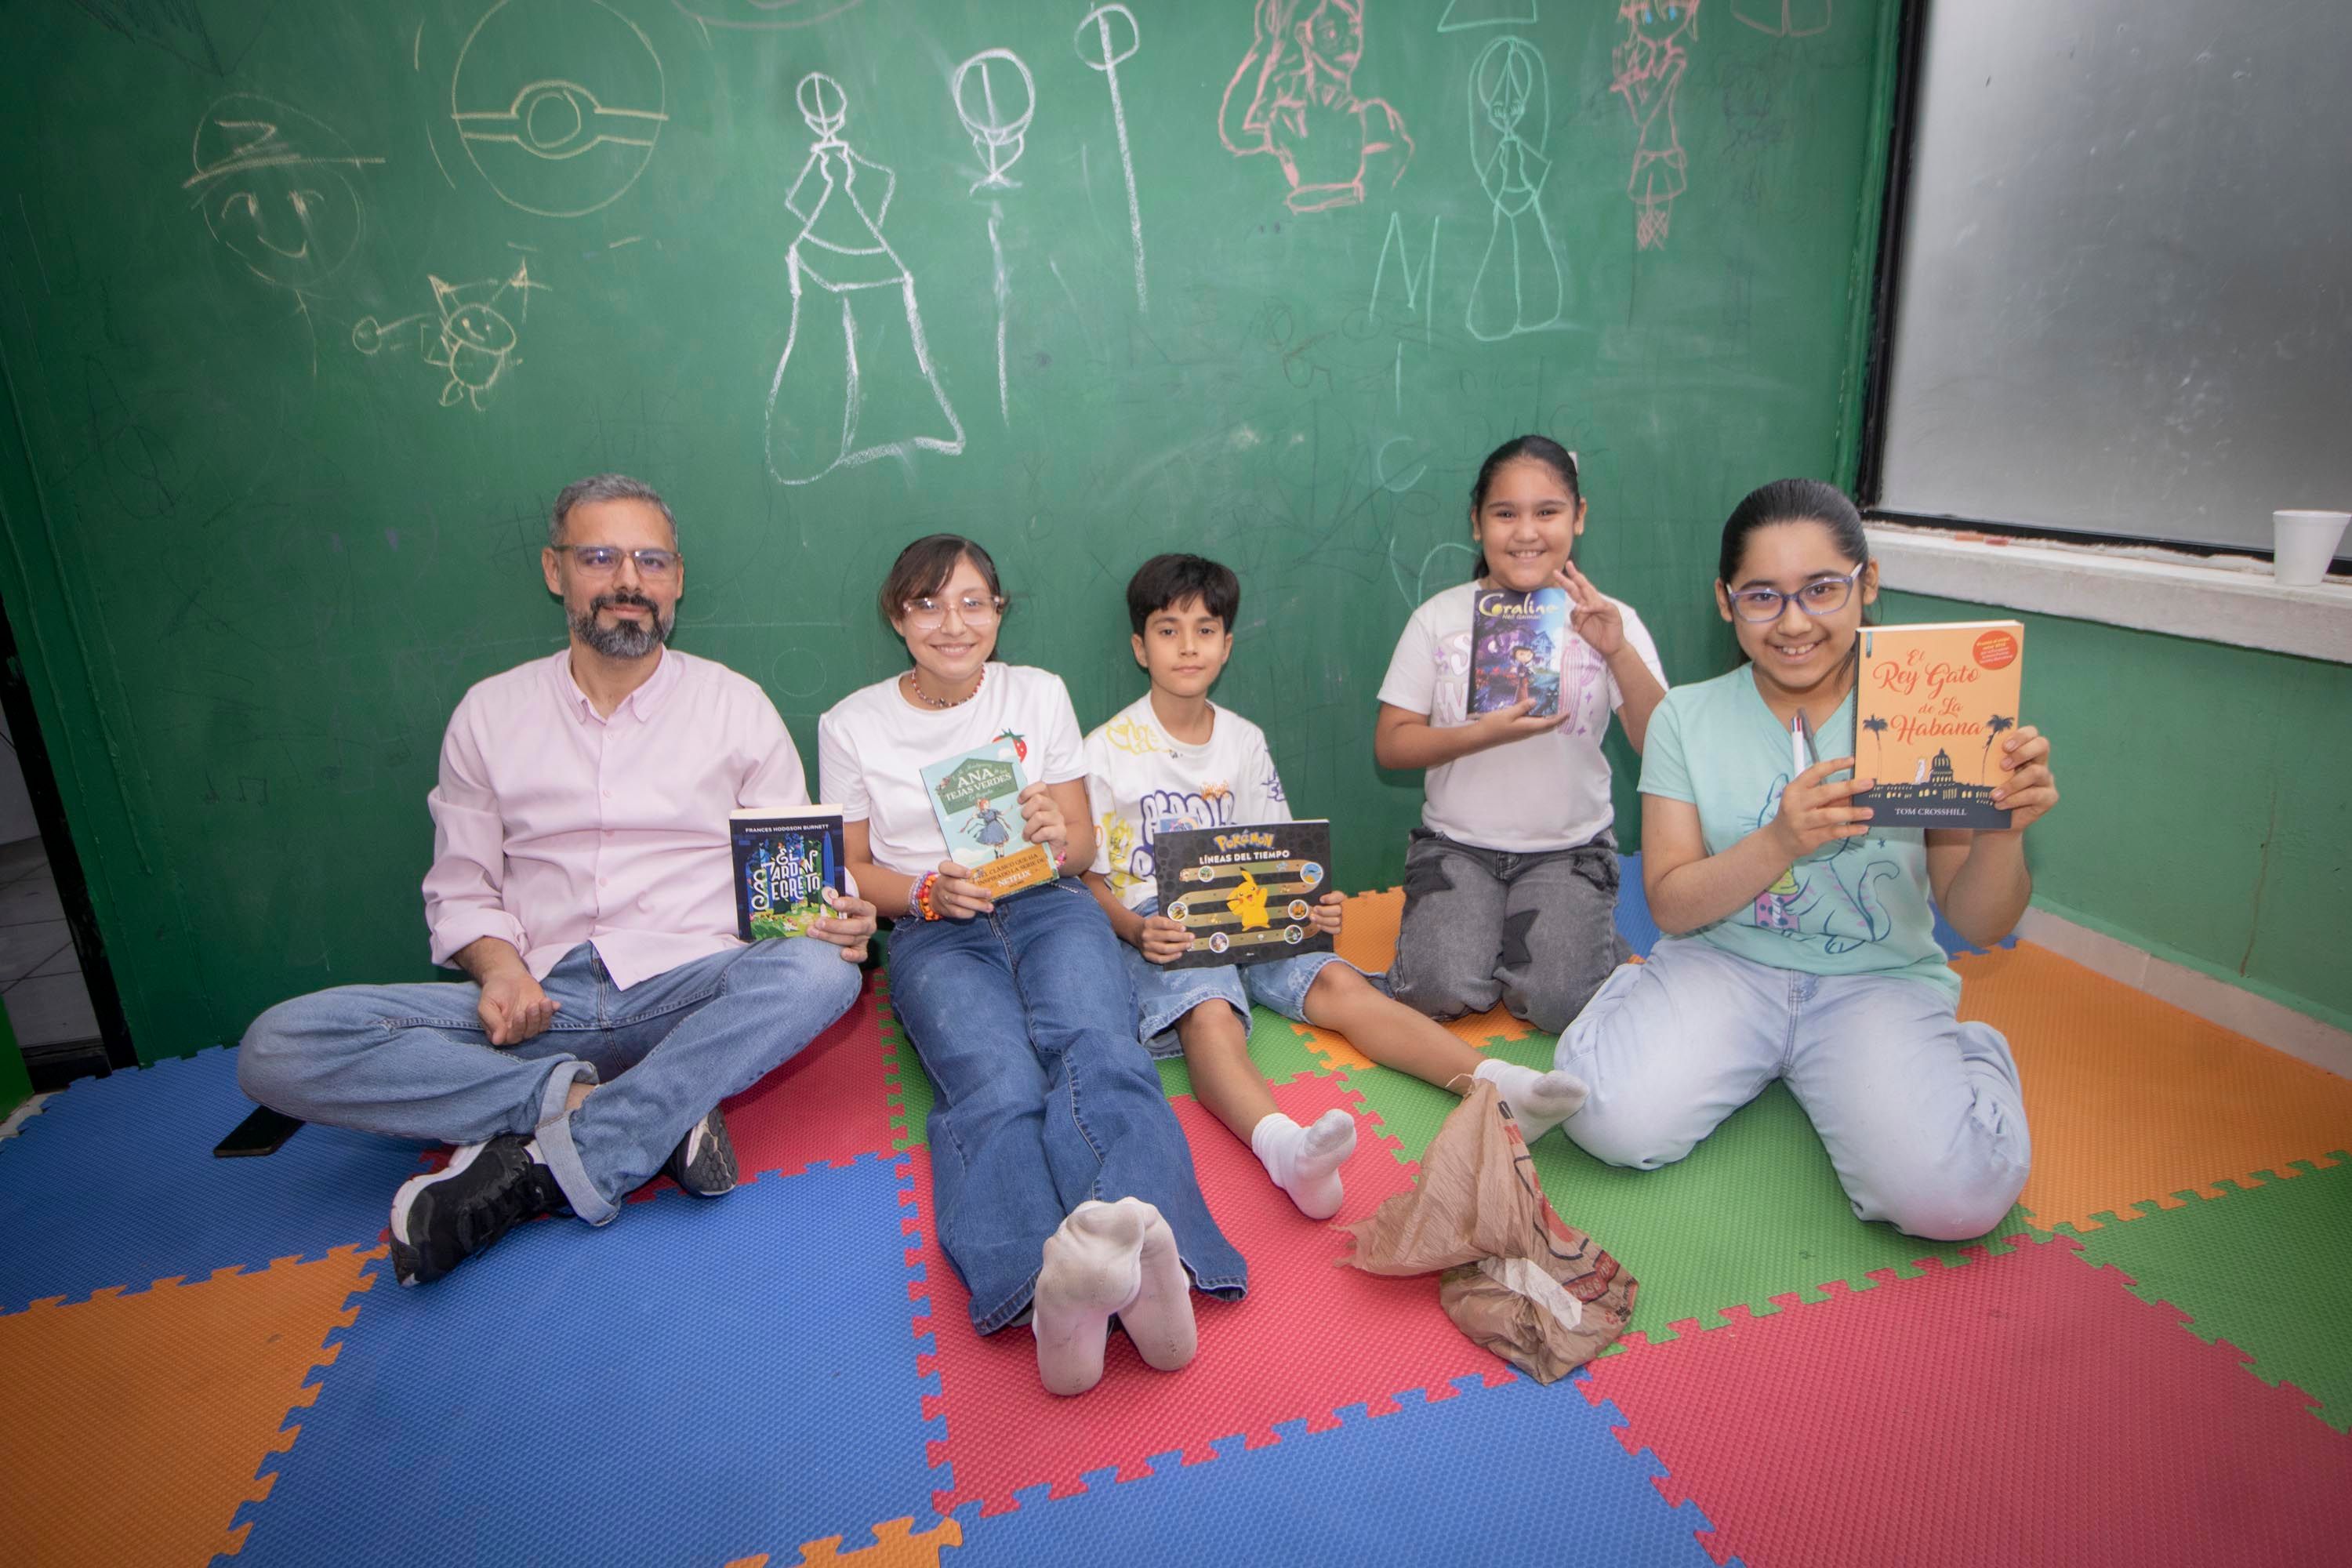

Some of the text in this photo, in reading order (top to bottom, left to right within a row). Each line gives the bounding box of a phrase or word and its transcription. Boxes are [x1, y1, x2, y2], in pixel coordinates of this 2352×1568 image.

[1479, 592, 1558, 617] Coraline
[1907, 648, 1925, 666] El
[1872, 661, 1980, 700] Rey Gato
[1918, 696, 1963, 719] de La
[1889, 714, 1984, 745] Habana
[946, 786, 974, 801] TEJAS
[974, 772, 1011, 789] VERDES
[957, 768, 994, 789] ANA
[1894, 807, 1967, 816] TOM CROSSHILL
[1199, 850, 1290, 865] LÍNEAS DEL TIEMPO
[751, 868, 821, 910] SECRETO
[997, 869, 1032, 887] NETFLIX
